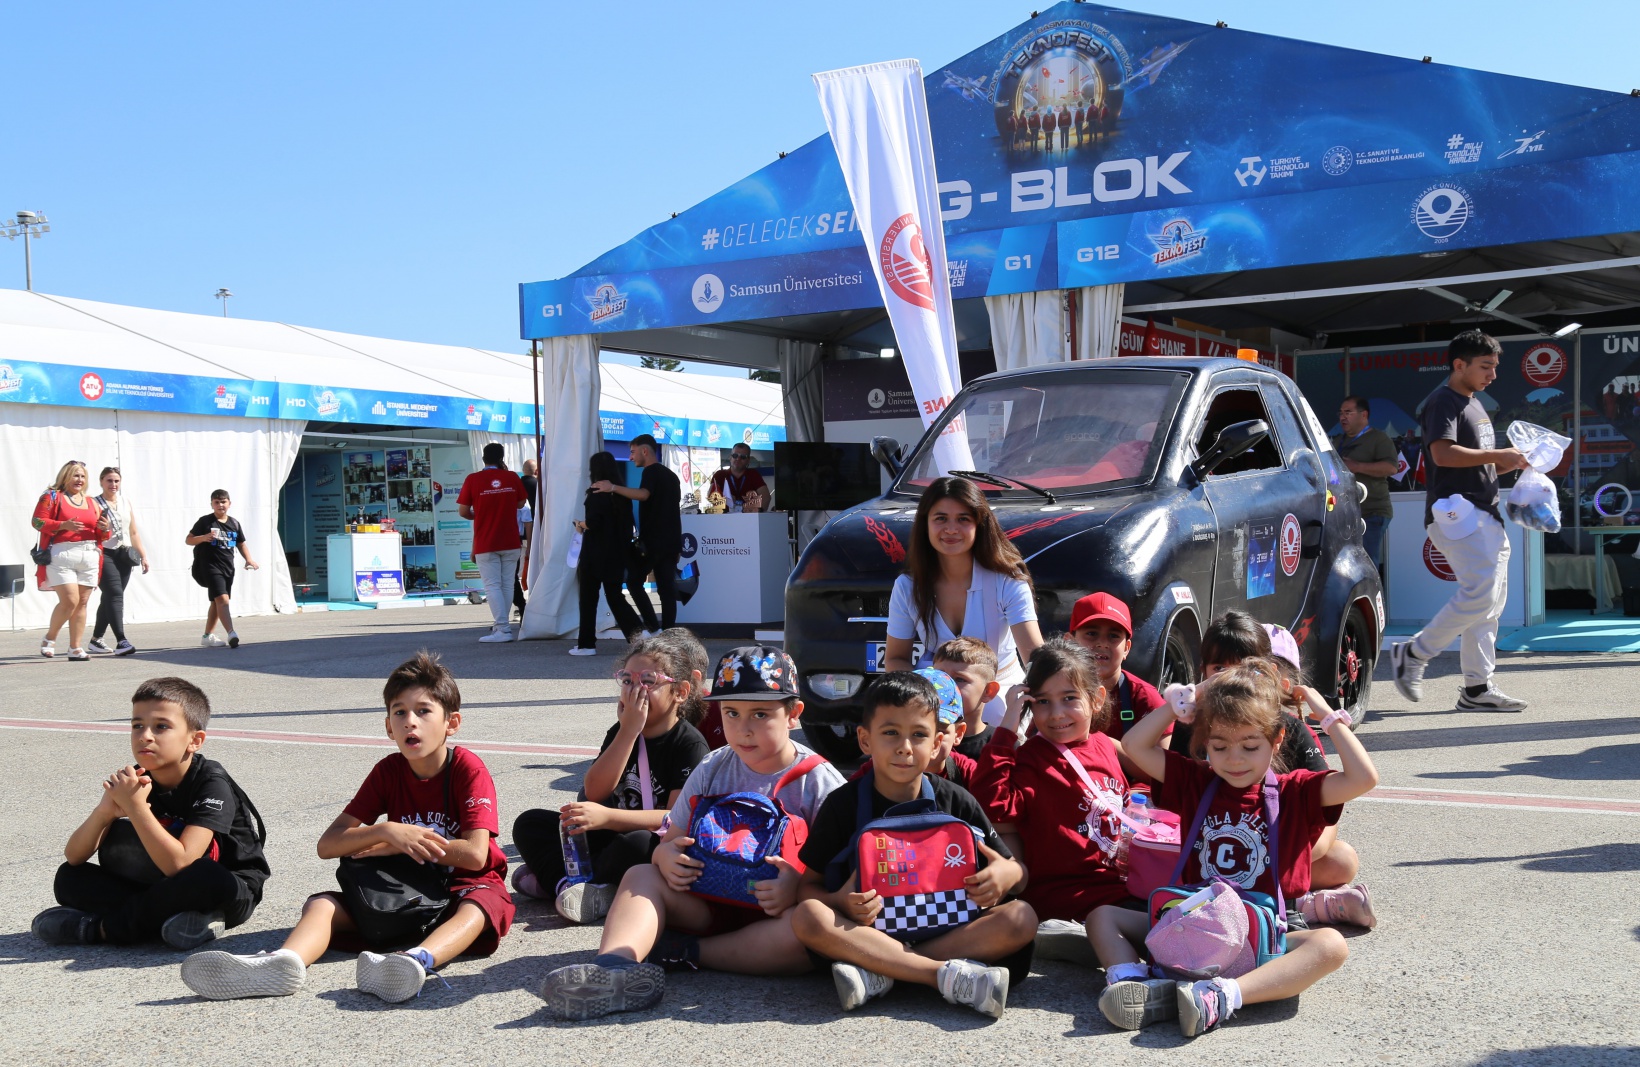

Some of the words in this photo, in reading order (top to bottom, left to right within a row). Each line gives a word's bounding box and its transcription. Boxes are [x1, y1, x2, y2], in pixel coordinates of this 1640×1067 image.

[1003, 31, 1115, 80] TEKNOFEST
[1356, 155, 1390, 166] TEKNOLOJİ
[1390, 151, 1425, 162] BAKANLIĞI
[1367, 149, 1390, 157] SANAYİ
[1076, 243, 1120, 263] G12
[1153, 235, 1206, 265] TEKNOFEST
[1004, 254, 1032, 271] G1
[729, 281, 781, 298] Samsun
[783, 270, 863, 292] Üniversitesi
[541, 303, 563, 318] G1
[589, 299, 627, 321] TEKNOFEST
[251, 395, 269, 405] H11
[286, 397, 306, 407] H10
[386, 401, 411, 410] İSTANBUL
[491, 413, 507, 422] H10
[701, 535, 735, 545] Samsun
[701, 544, 751, 556] Üniversitesi
[867, 659, 876, 667] TR
[1216, 843, 1236, 870] C
